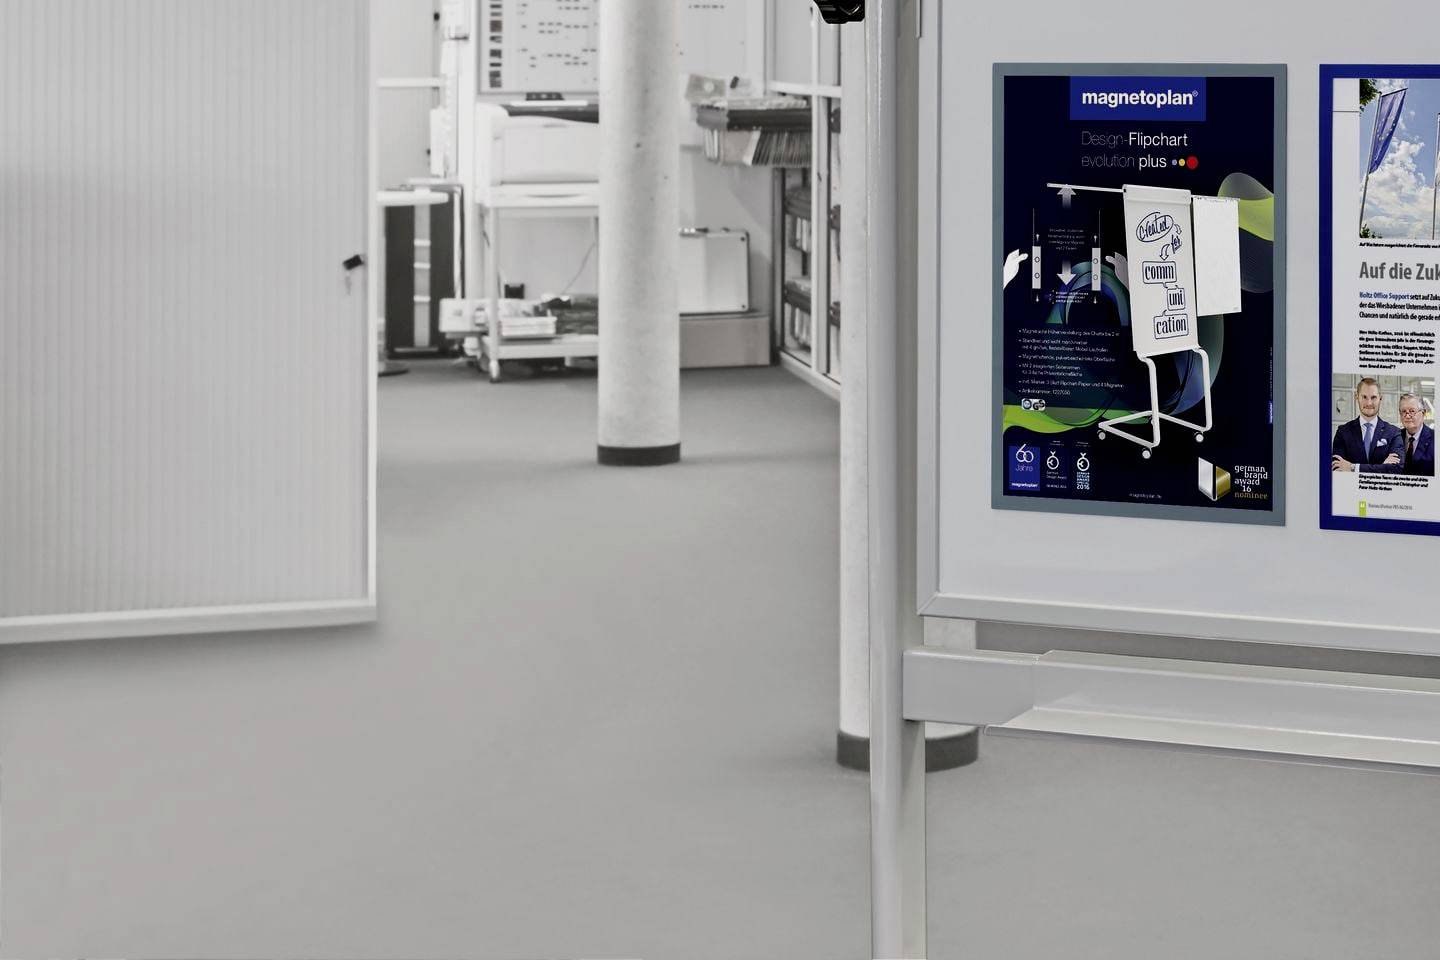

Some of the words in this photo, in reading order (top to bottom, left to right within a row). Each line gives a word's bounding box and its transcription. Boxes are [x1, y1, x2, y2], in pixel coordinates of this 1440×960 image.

[1081, 130, 1188, 149] Design-Flipchart
[1081, 153, 1134, 167] evolution
[1138, 153, 1168, 171] plus
[1139, 216, 1168, 240] created
[1171, 234, 1182, 254] for
[1145, 264, 1174, 280] comm
[1359, 261, 1386, 278] Auf
[1388, 262, 1412, 279] die
[1168, 290, 1184, 306] uni
[1388, 292, 1409, 300] Support
[1156, 316, 1186, 335] cation
[1016, 464, 1033, 472] Jahre
[1234, 465, 1266, 474] german
[1244, 471, 1268, 480] brand
[1234, 478, 1260, 486] award
